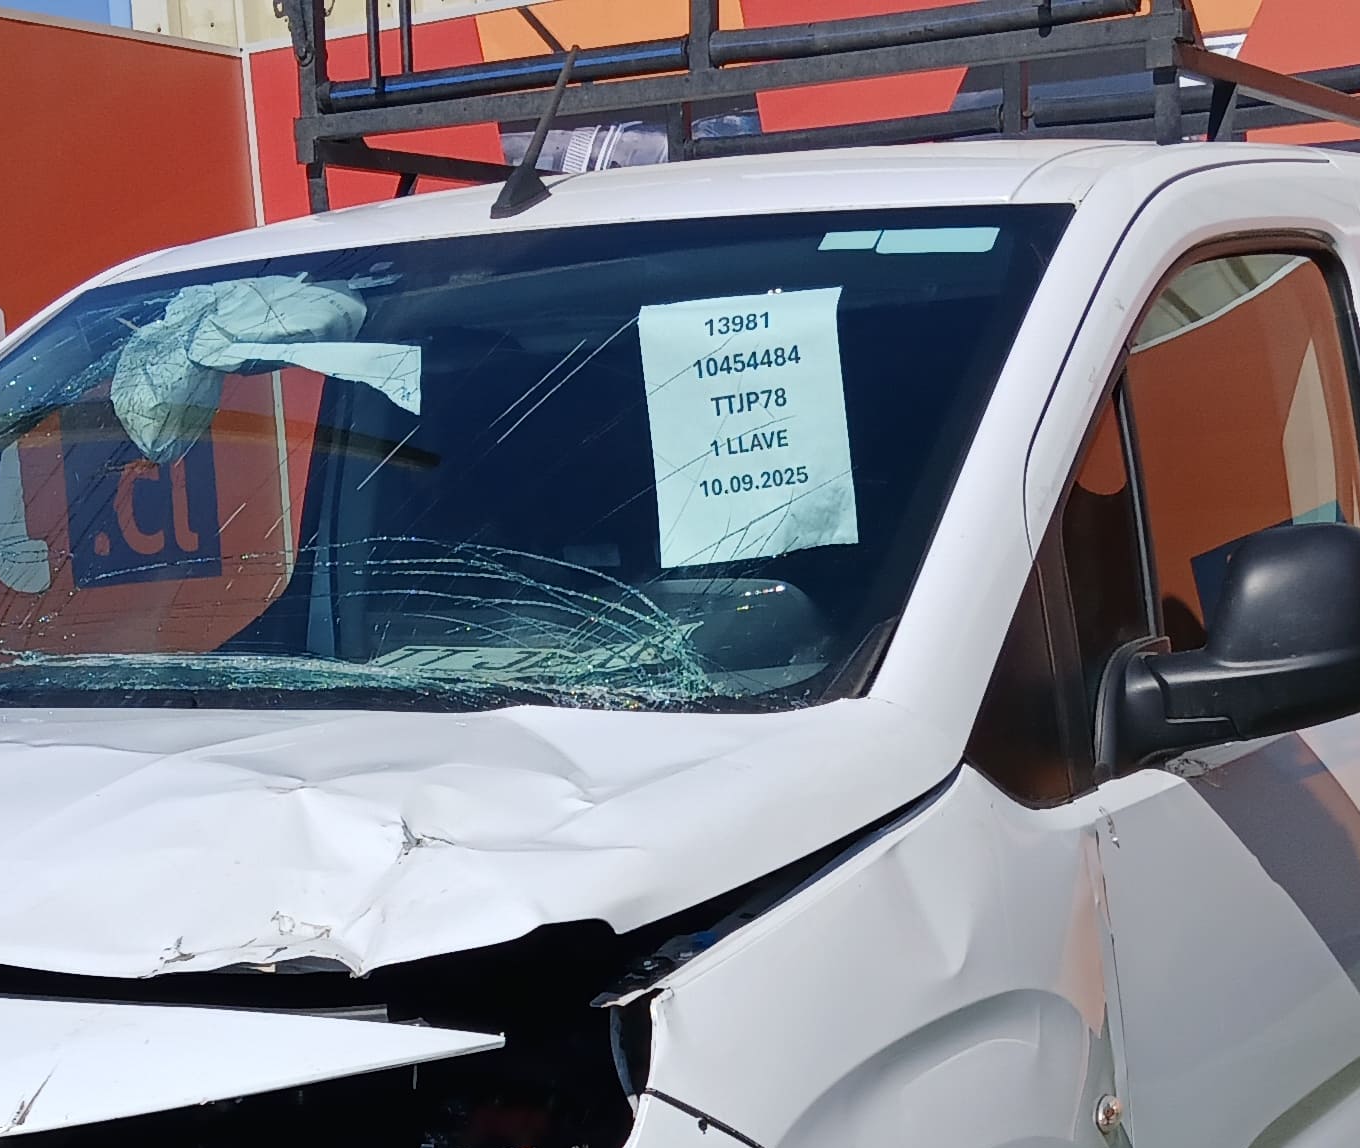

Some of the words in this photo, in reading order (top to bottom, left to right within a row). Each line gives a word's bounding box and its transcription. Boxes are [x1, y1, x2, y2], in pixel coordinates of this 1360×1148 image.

[704, 311, 770, 336] 13981
[693, 345, 801, 379] 10454484
[710, 387, 788, 416] TTJP78
[710, 440, 720, 457] 1
[727, 429, 789, 456] LLAVE
[699, 466, 809, 498] 10.09.2025
